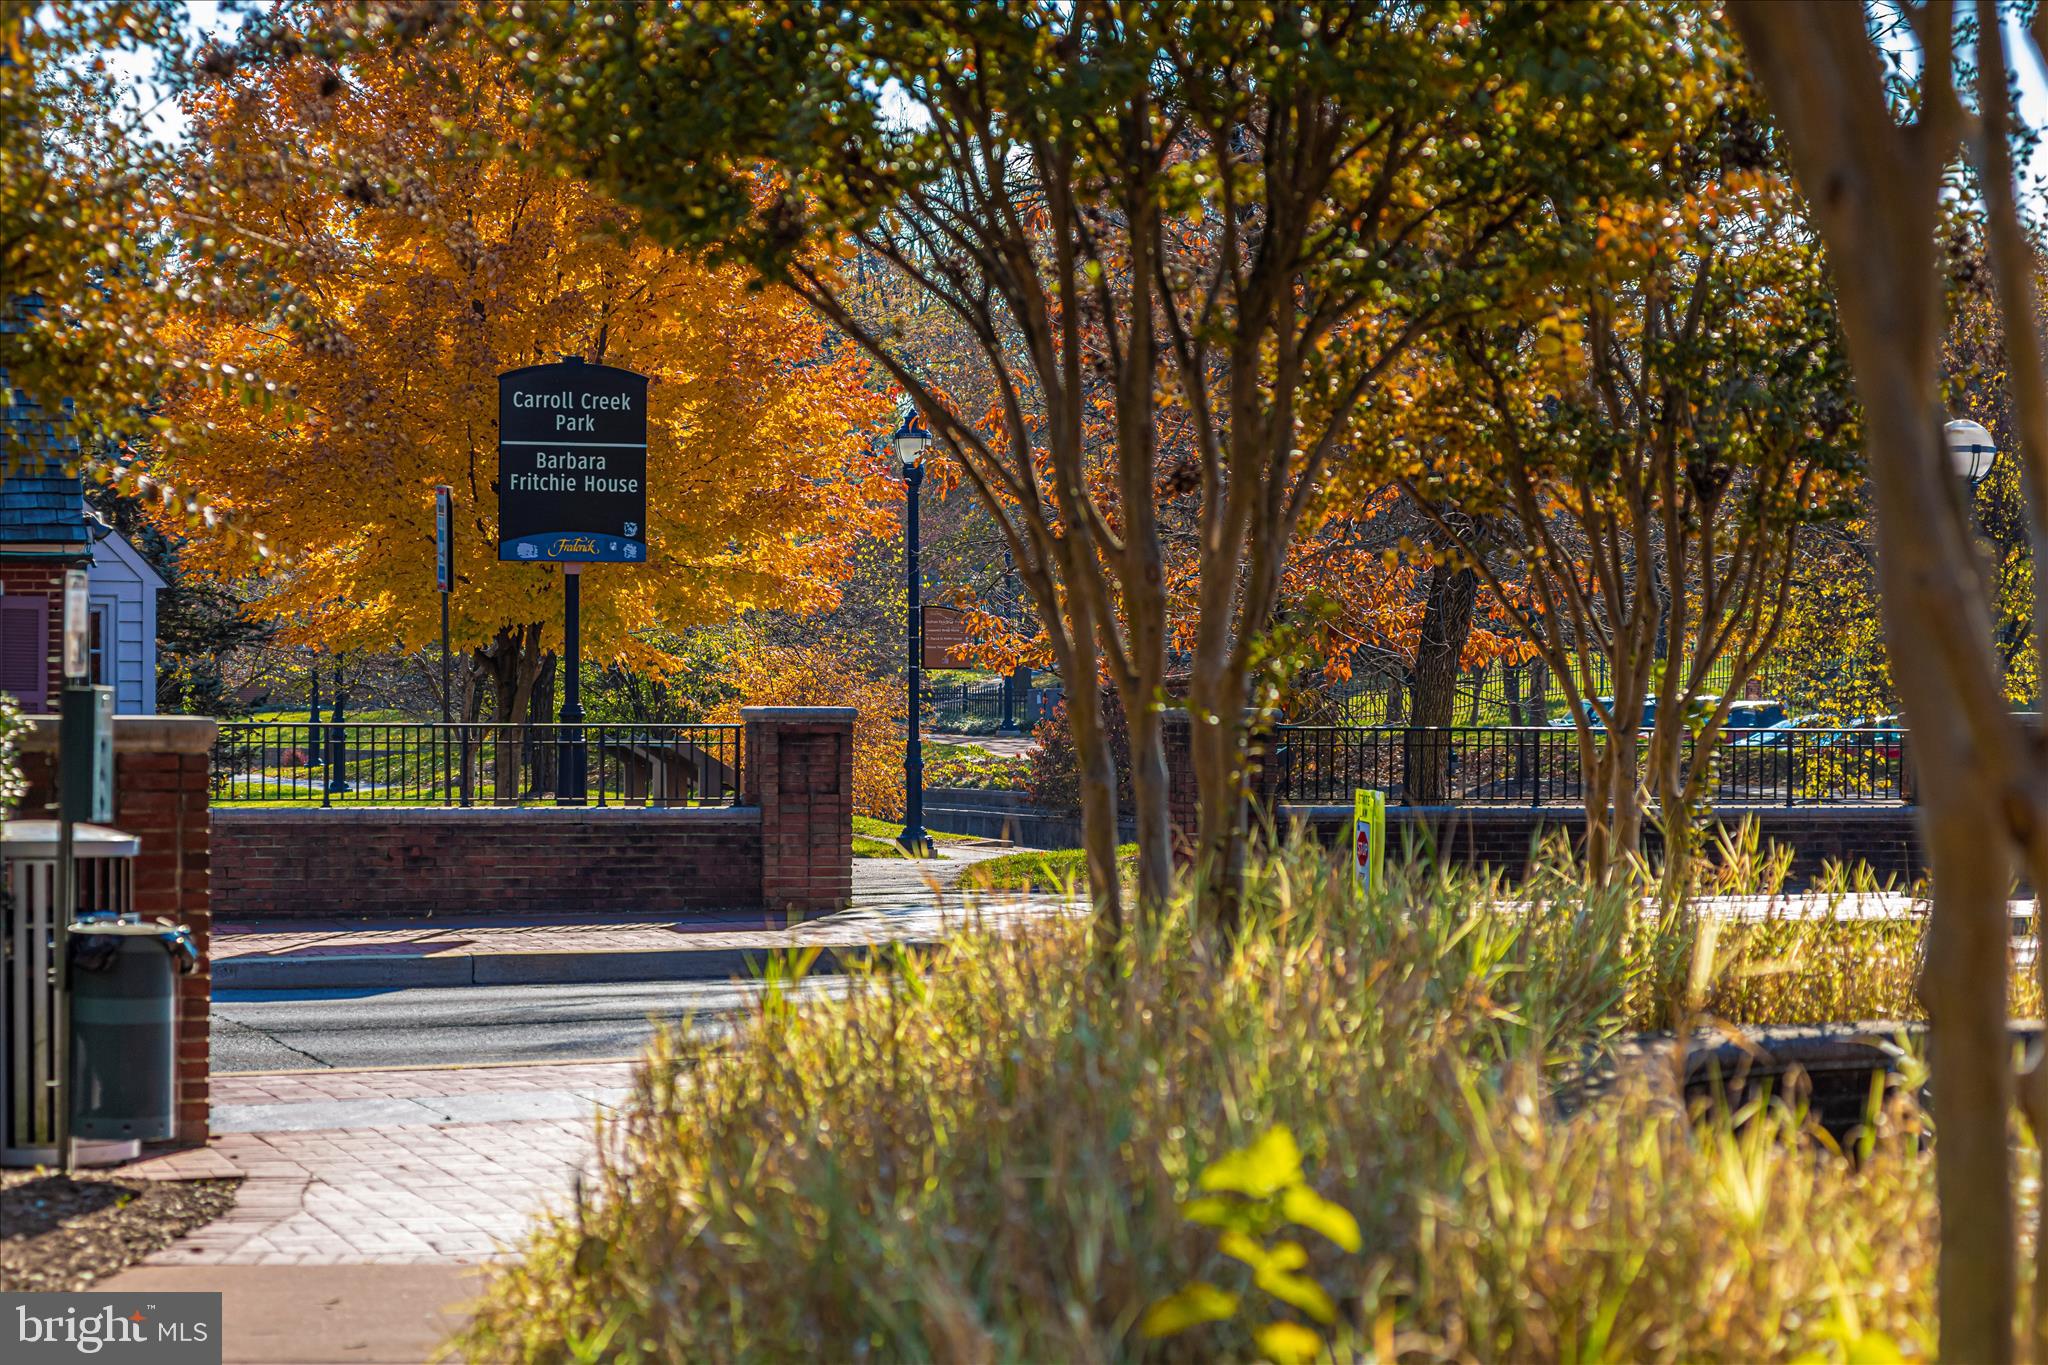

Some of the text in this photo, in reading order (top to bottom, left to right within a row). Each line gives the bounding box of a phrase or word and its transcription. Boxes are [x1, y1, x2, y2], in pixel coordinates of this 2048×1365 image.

[513, 391, 631, 411] Carroll Creek
[556, 414, 595, 432] Park
[536, 452, 606, 470] Barbara
[510, 473, 638, 493] Fritchie House
[547, 536, 600, 557] Frederick
